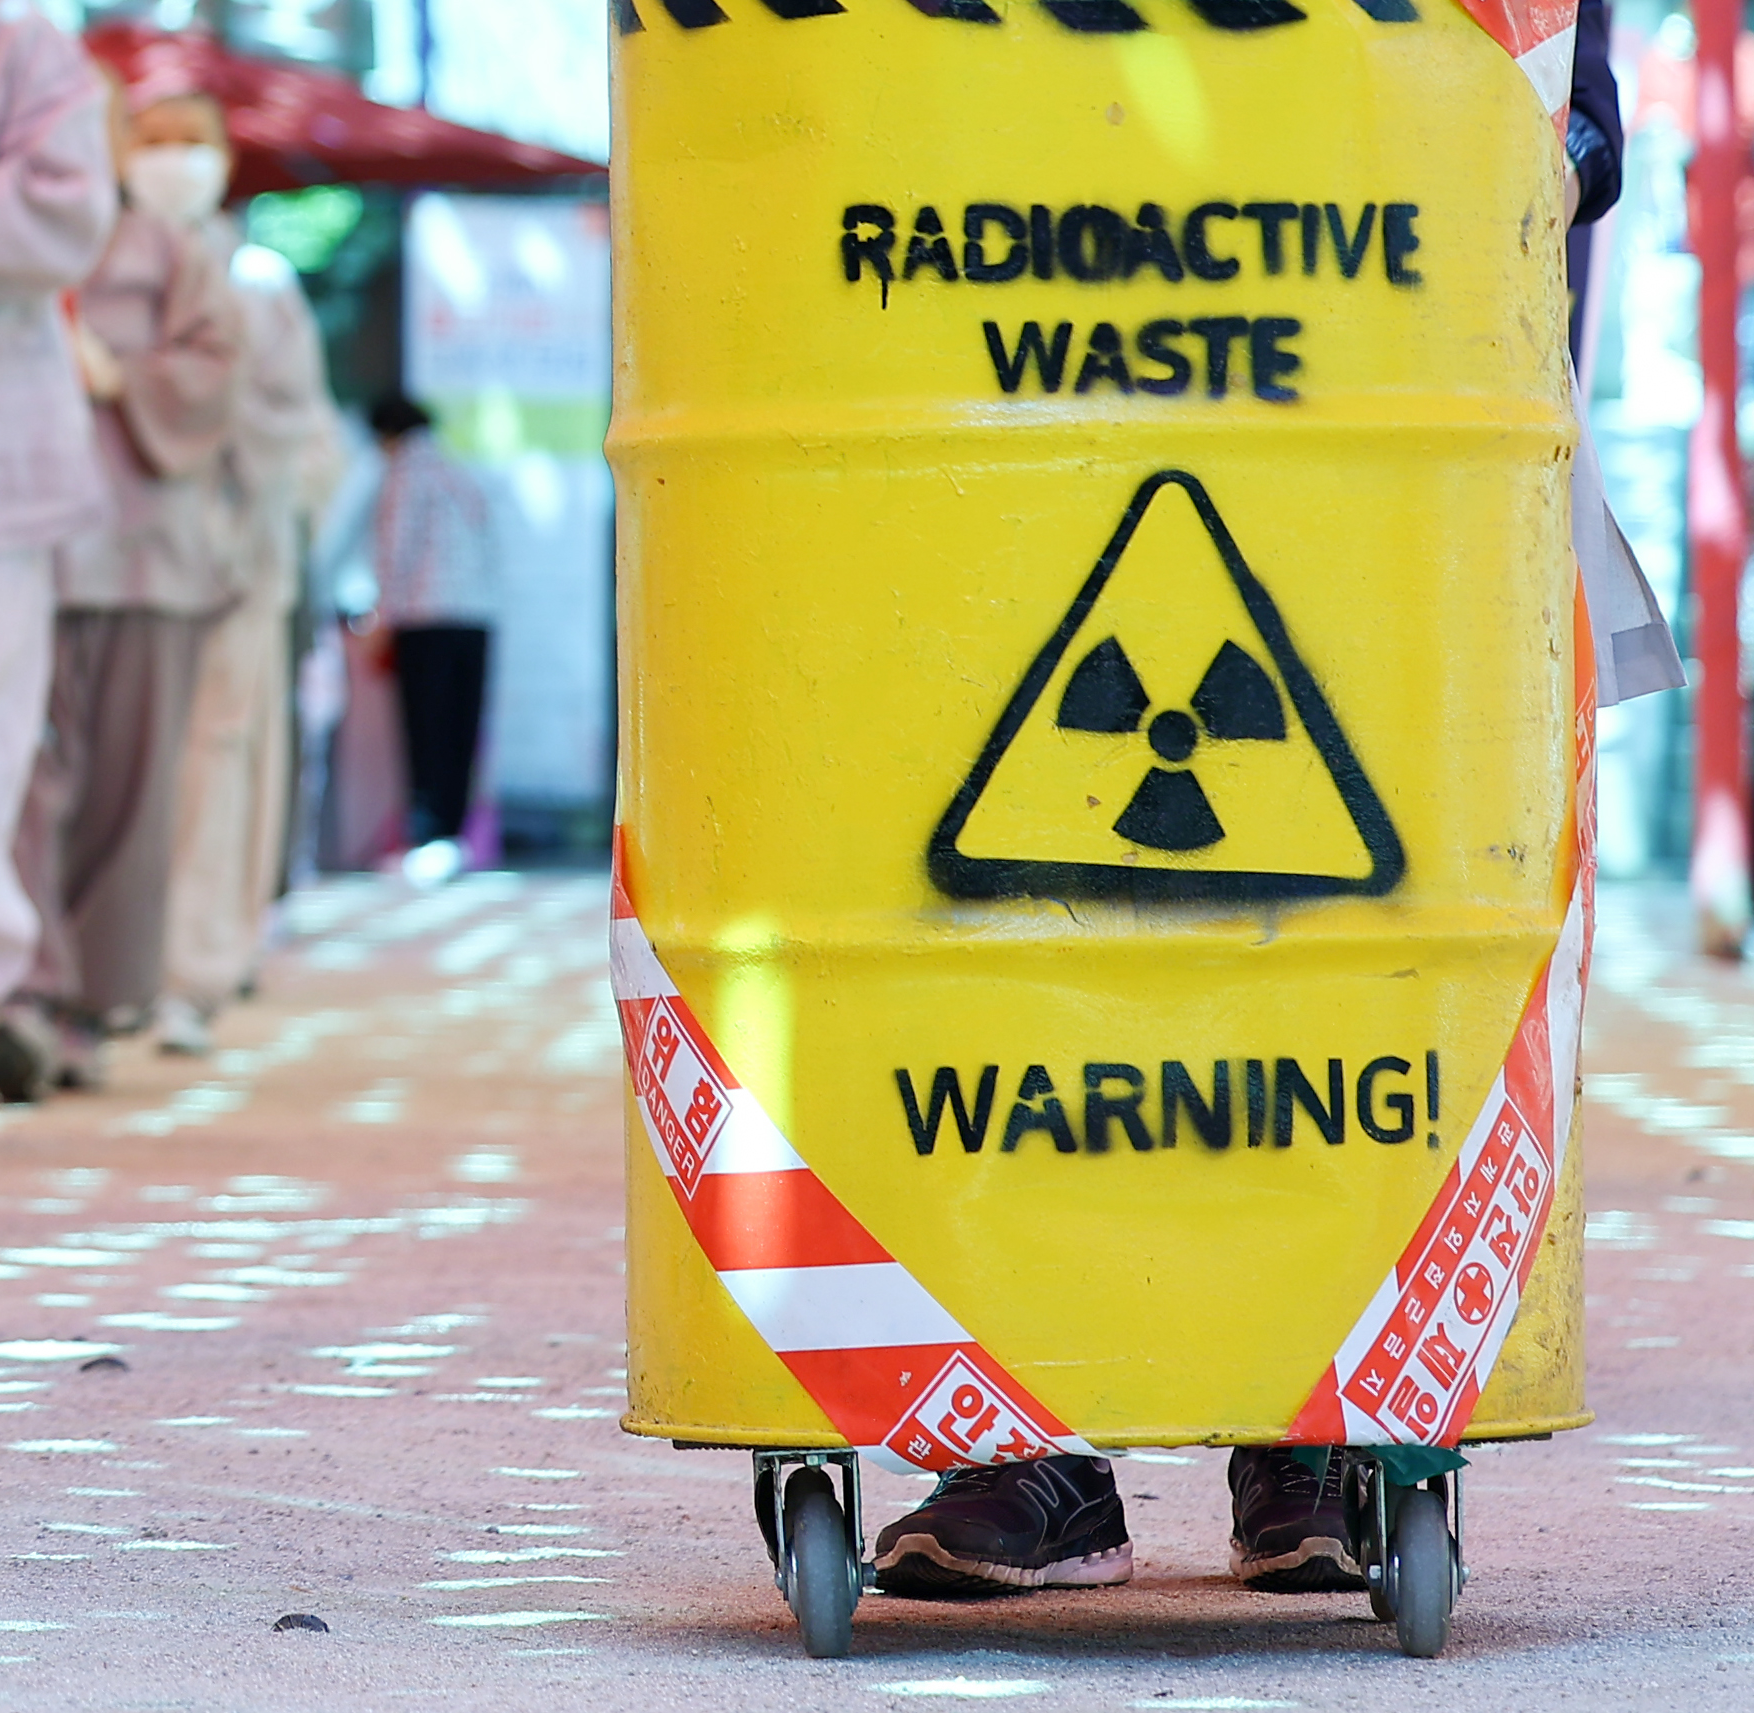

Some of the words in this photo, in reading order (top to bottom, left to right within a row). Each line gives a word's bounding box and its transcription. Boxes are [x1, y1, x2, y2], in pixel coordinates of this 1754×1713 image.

[839, 199, 1424, 293] RADIOACTIVE
[980, 315, 1304, 403] WASTE
[642, 1065, 696, 1179] DANGER
[651, 1014, 723, 1149] 위험
[894, 1050, 1441, 1156] WARNING!
[1480, 1151, 1540, 1271] 안전
[1387, 1321, 1468, 1442] 제일
